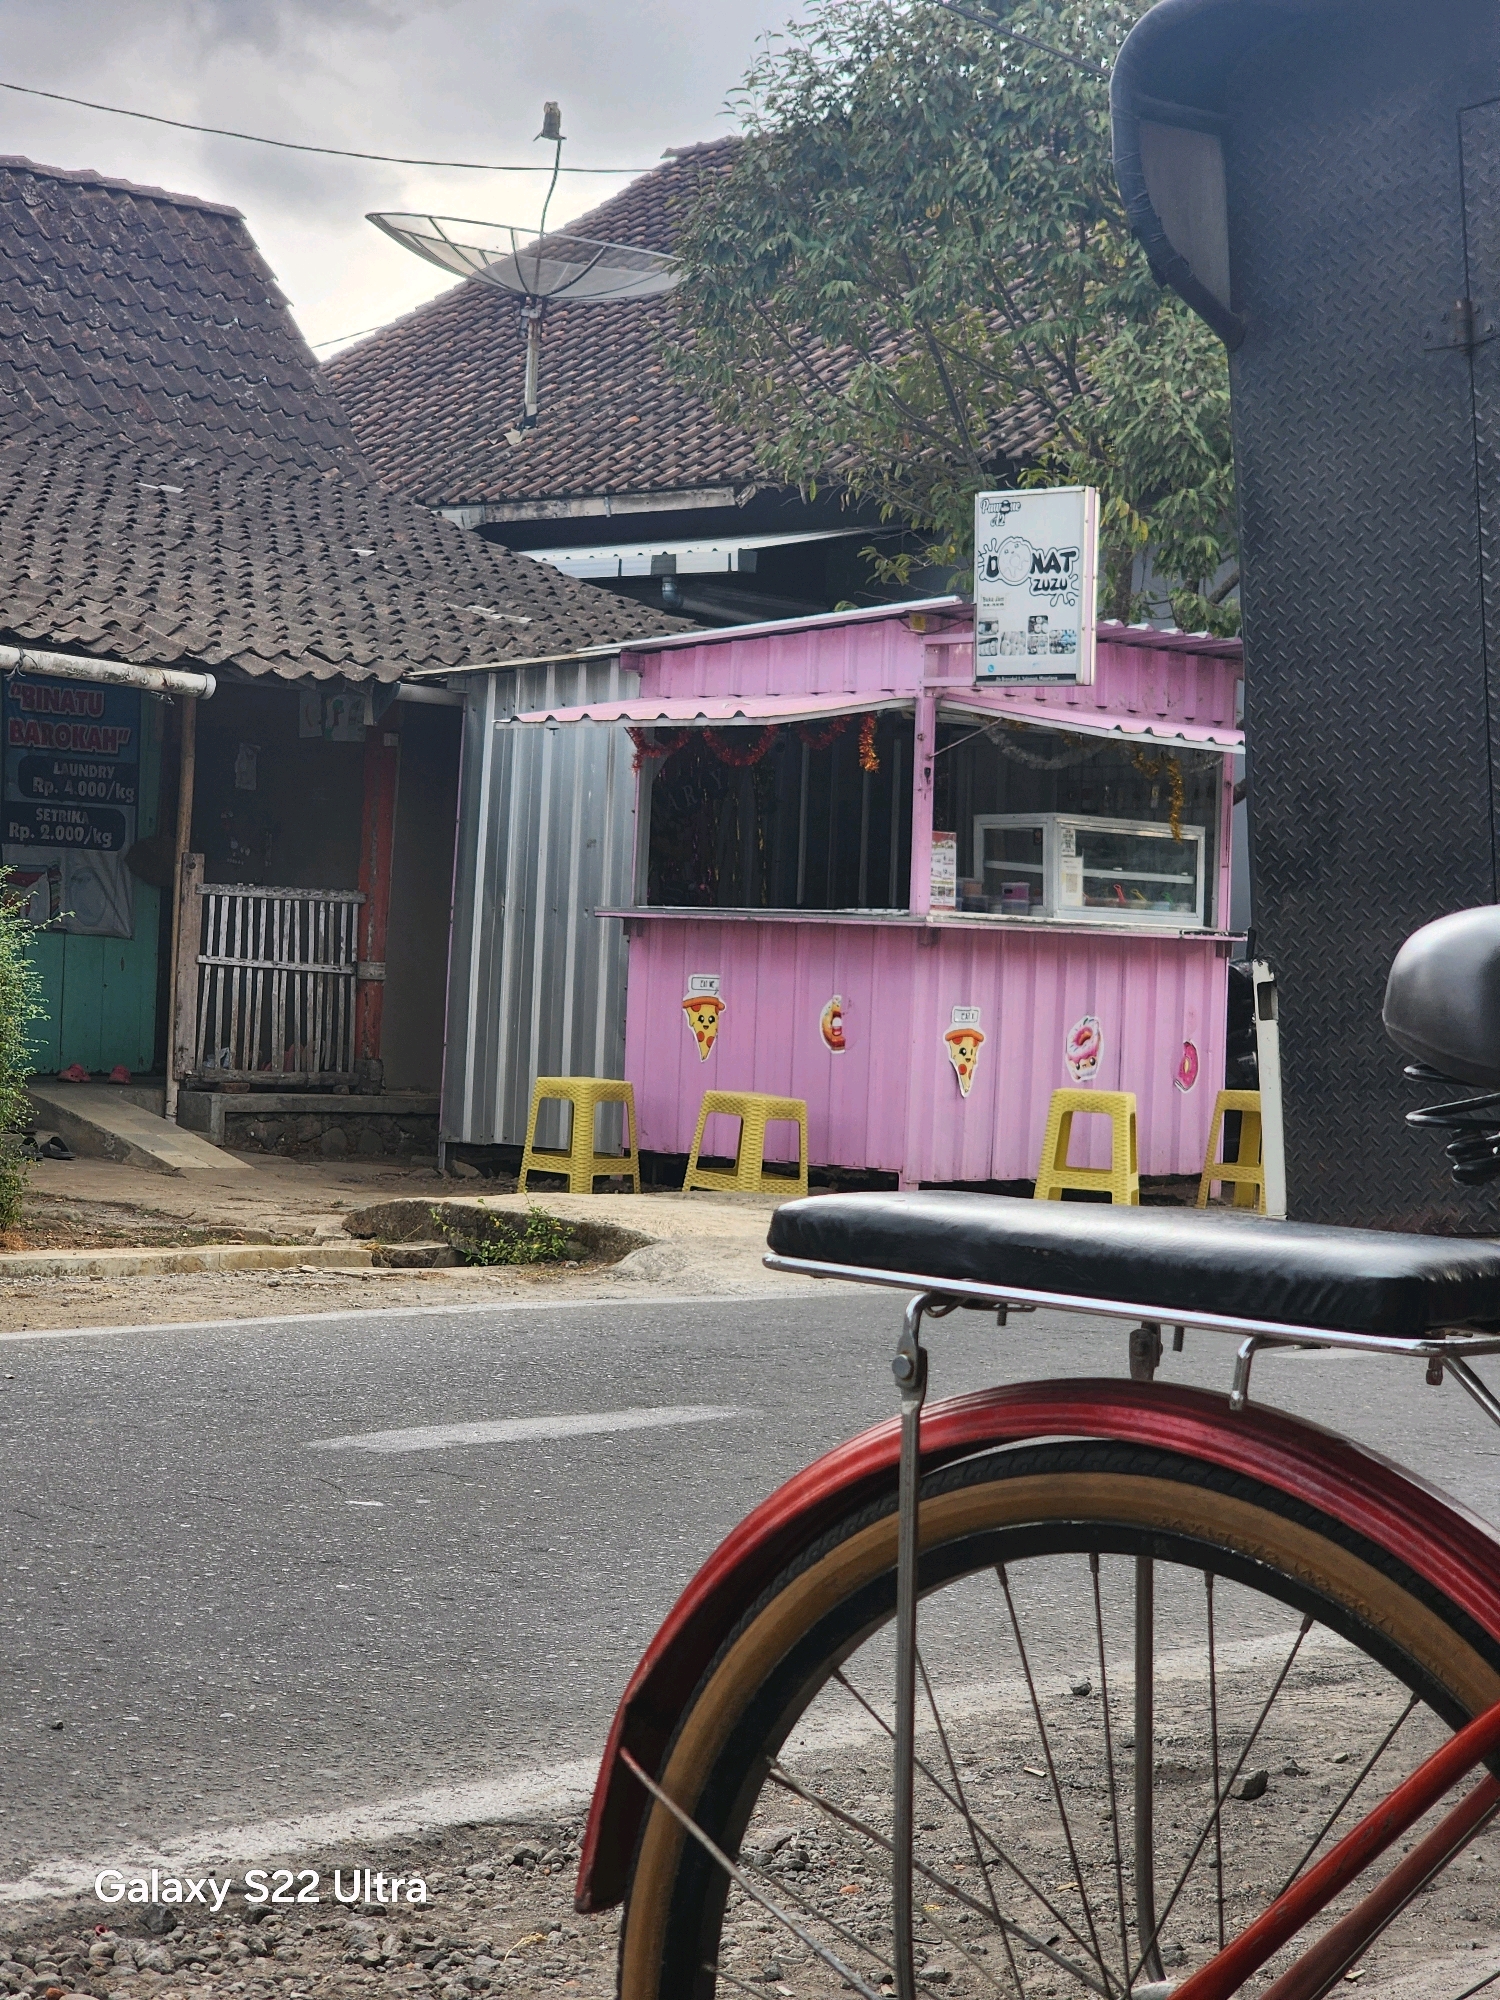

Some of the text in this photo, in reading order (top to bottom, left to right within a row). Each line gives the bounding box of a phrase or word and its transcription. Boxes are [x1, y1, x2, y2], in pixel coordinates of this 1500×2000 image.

[1033, 578, 1068, 592] ZUZU
[9, 717, 130, 753] BAROKAH"
[53, 762, 115, 779] LAUNDRY
[33, 776, 135, 803] Rp. 4.000/kg
[36, 807, 90, 824] SETRIKA
[8, 821, 112, 848] Rp. 2.000/kg
